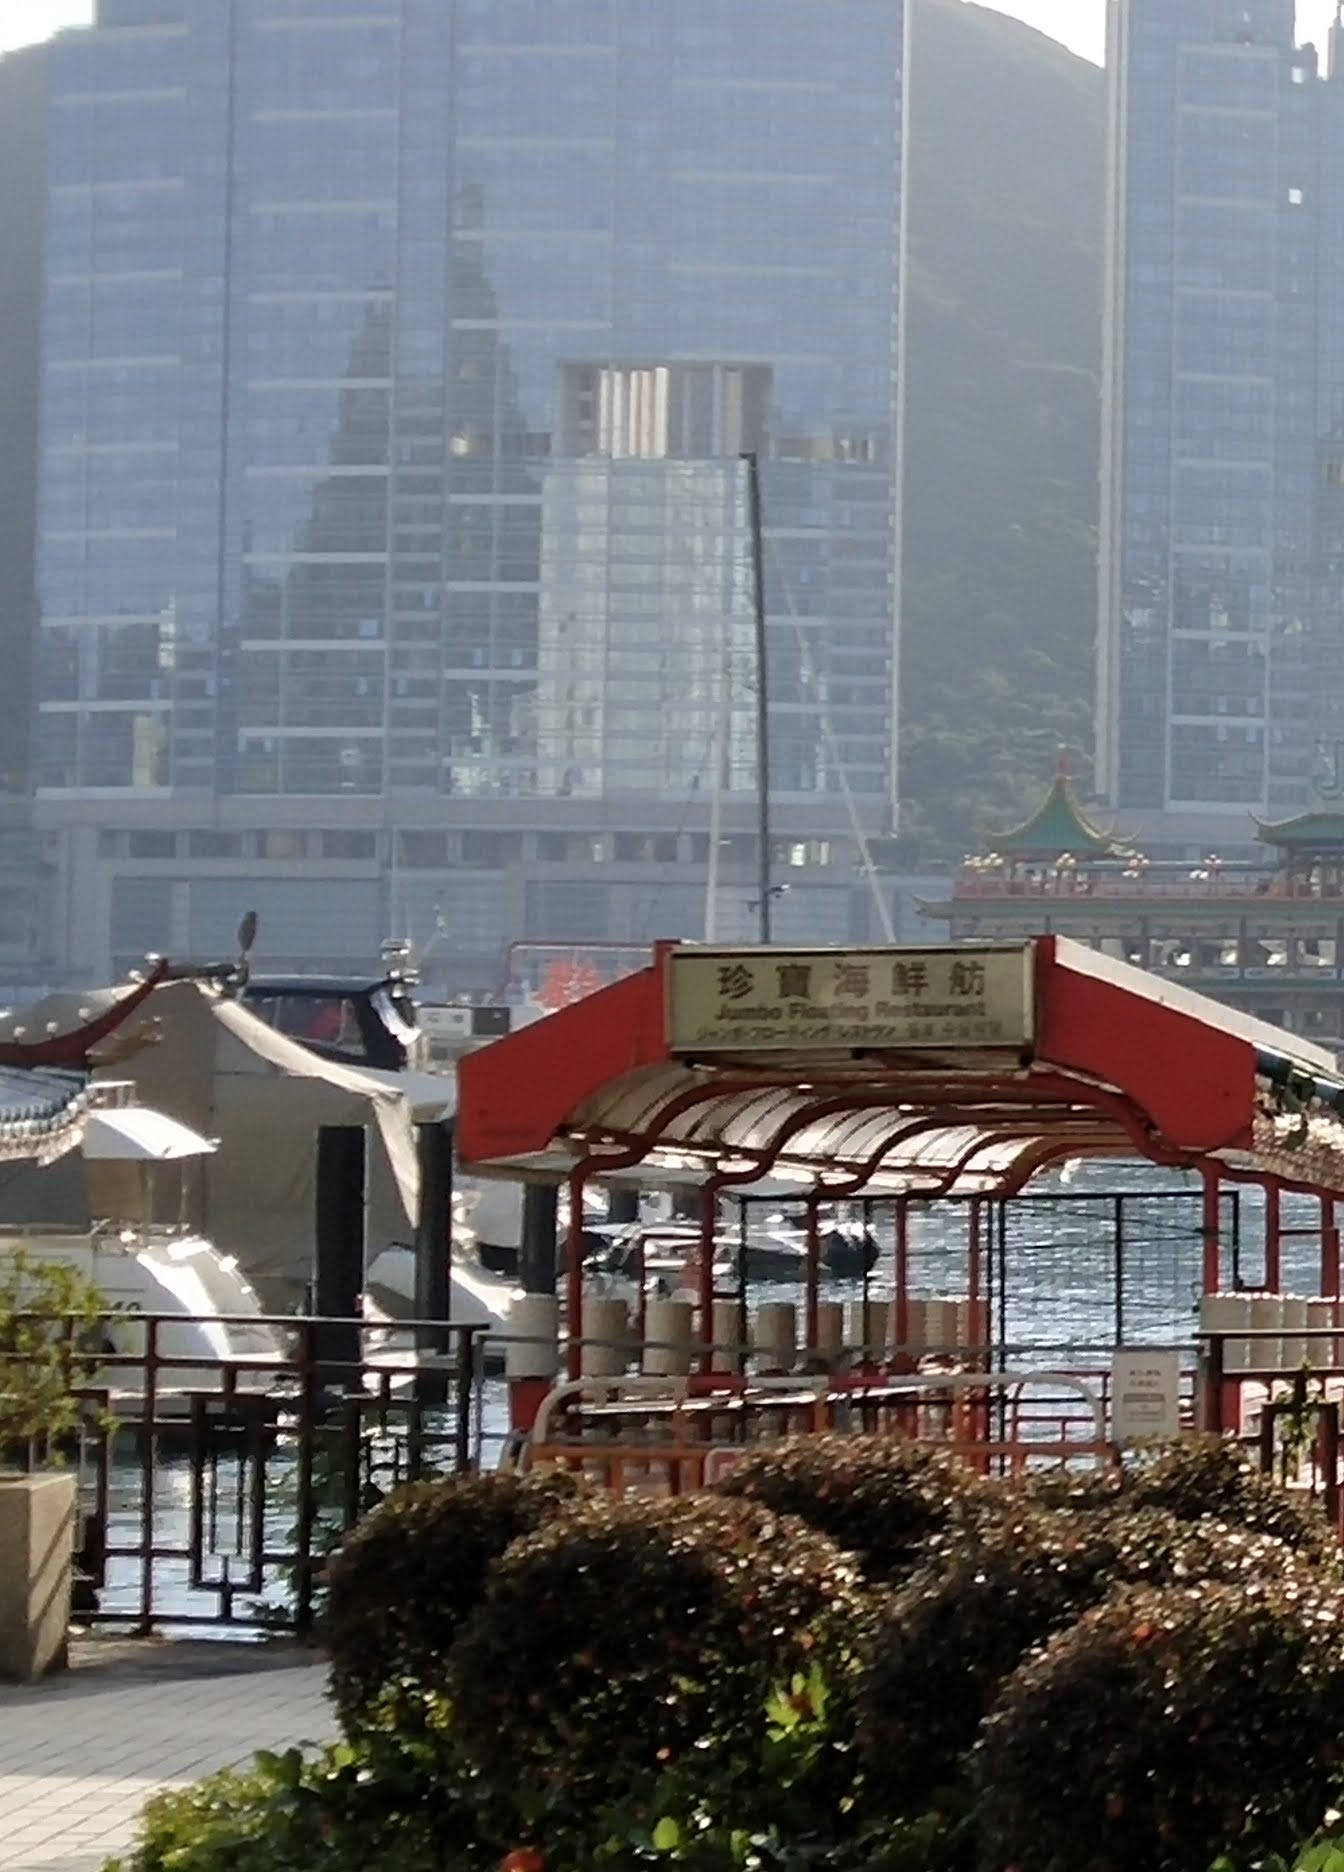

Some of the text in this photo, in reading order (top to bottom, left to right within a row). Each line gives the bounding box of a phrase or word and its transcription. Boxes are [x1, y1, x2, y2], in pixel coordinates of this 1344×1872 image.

[717, 964, 985, 999] 珍寶海鮮舫
[715, 1001, 986, 1022] Jumbo Floating Restaurant
